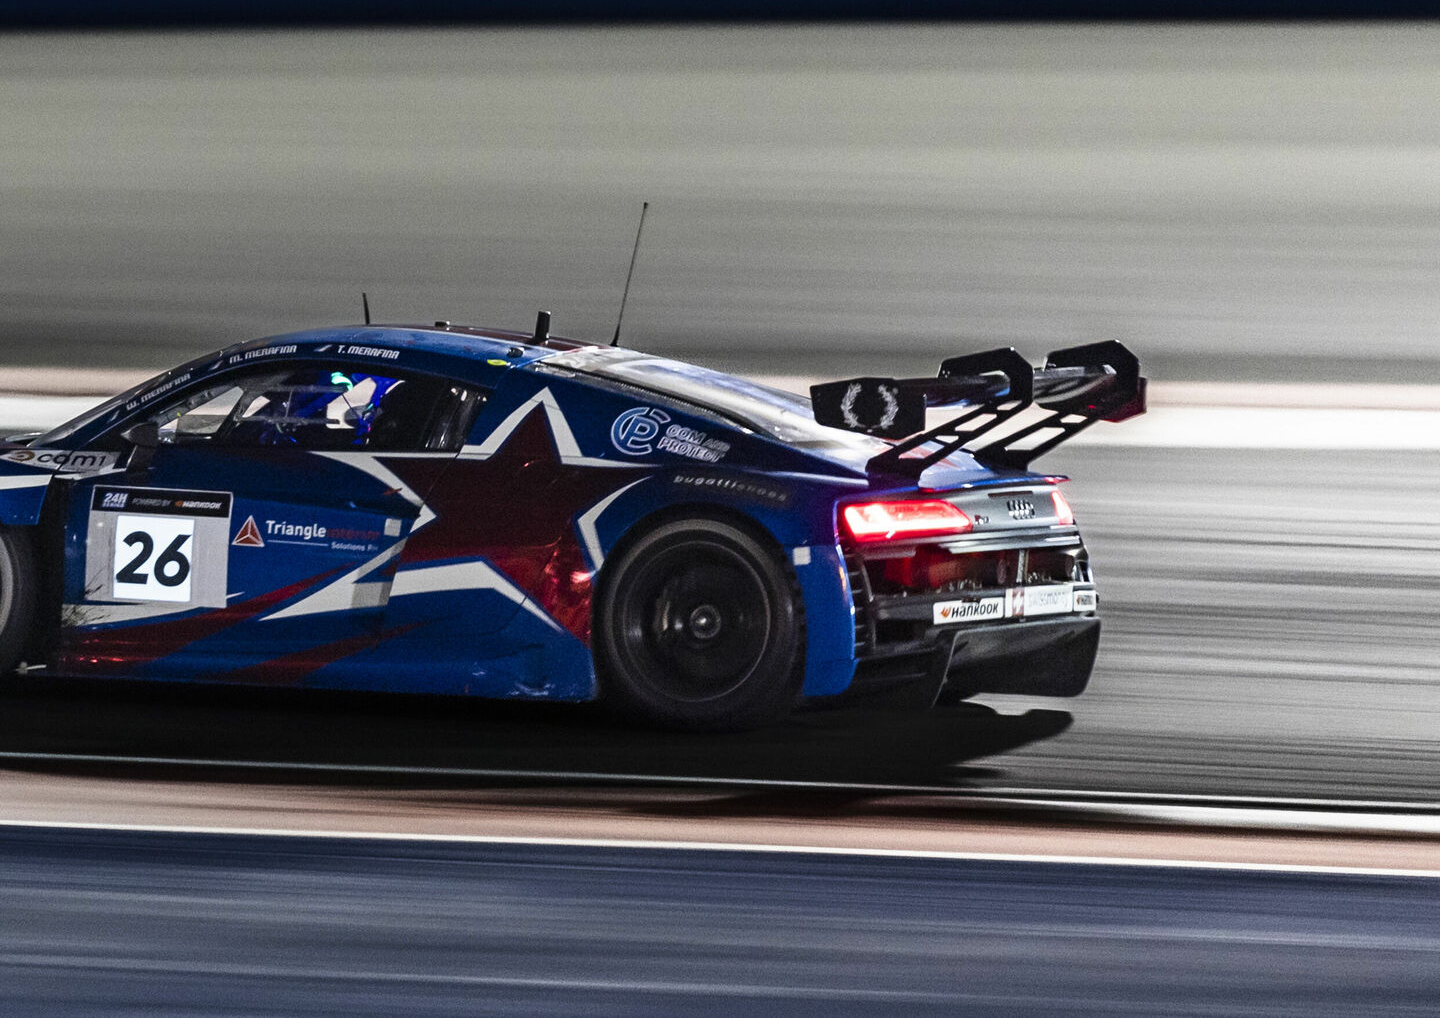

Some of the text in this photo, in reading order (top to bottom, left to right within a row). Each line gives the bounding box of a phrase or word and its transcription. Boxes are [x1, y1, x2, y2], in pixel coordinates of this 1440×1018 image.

[244, 344, 298, 362] MERAFINA
[347, 345, 400, 360] MERAFINA
[103, 492, 129, 504] 24H
[265, 519, 327, 540] Triangle
[331, 541, 365, 552] Solutions
[116, 530, 193, 587] 26
